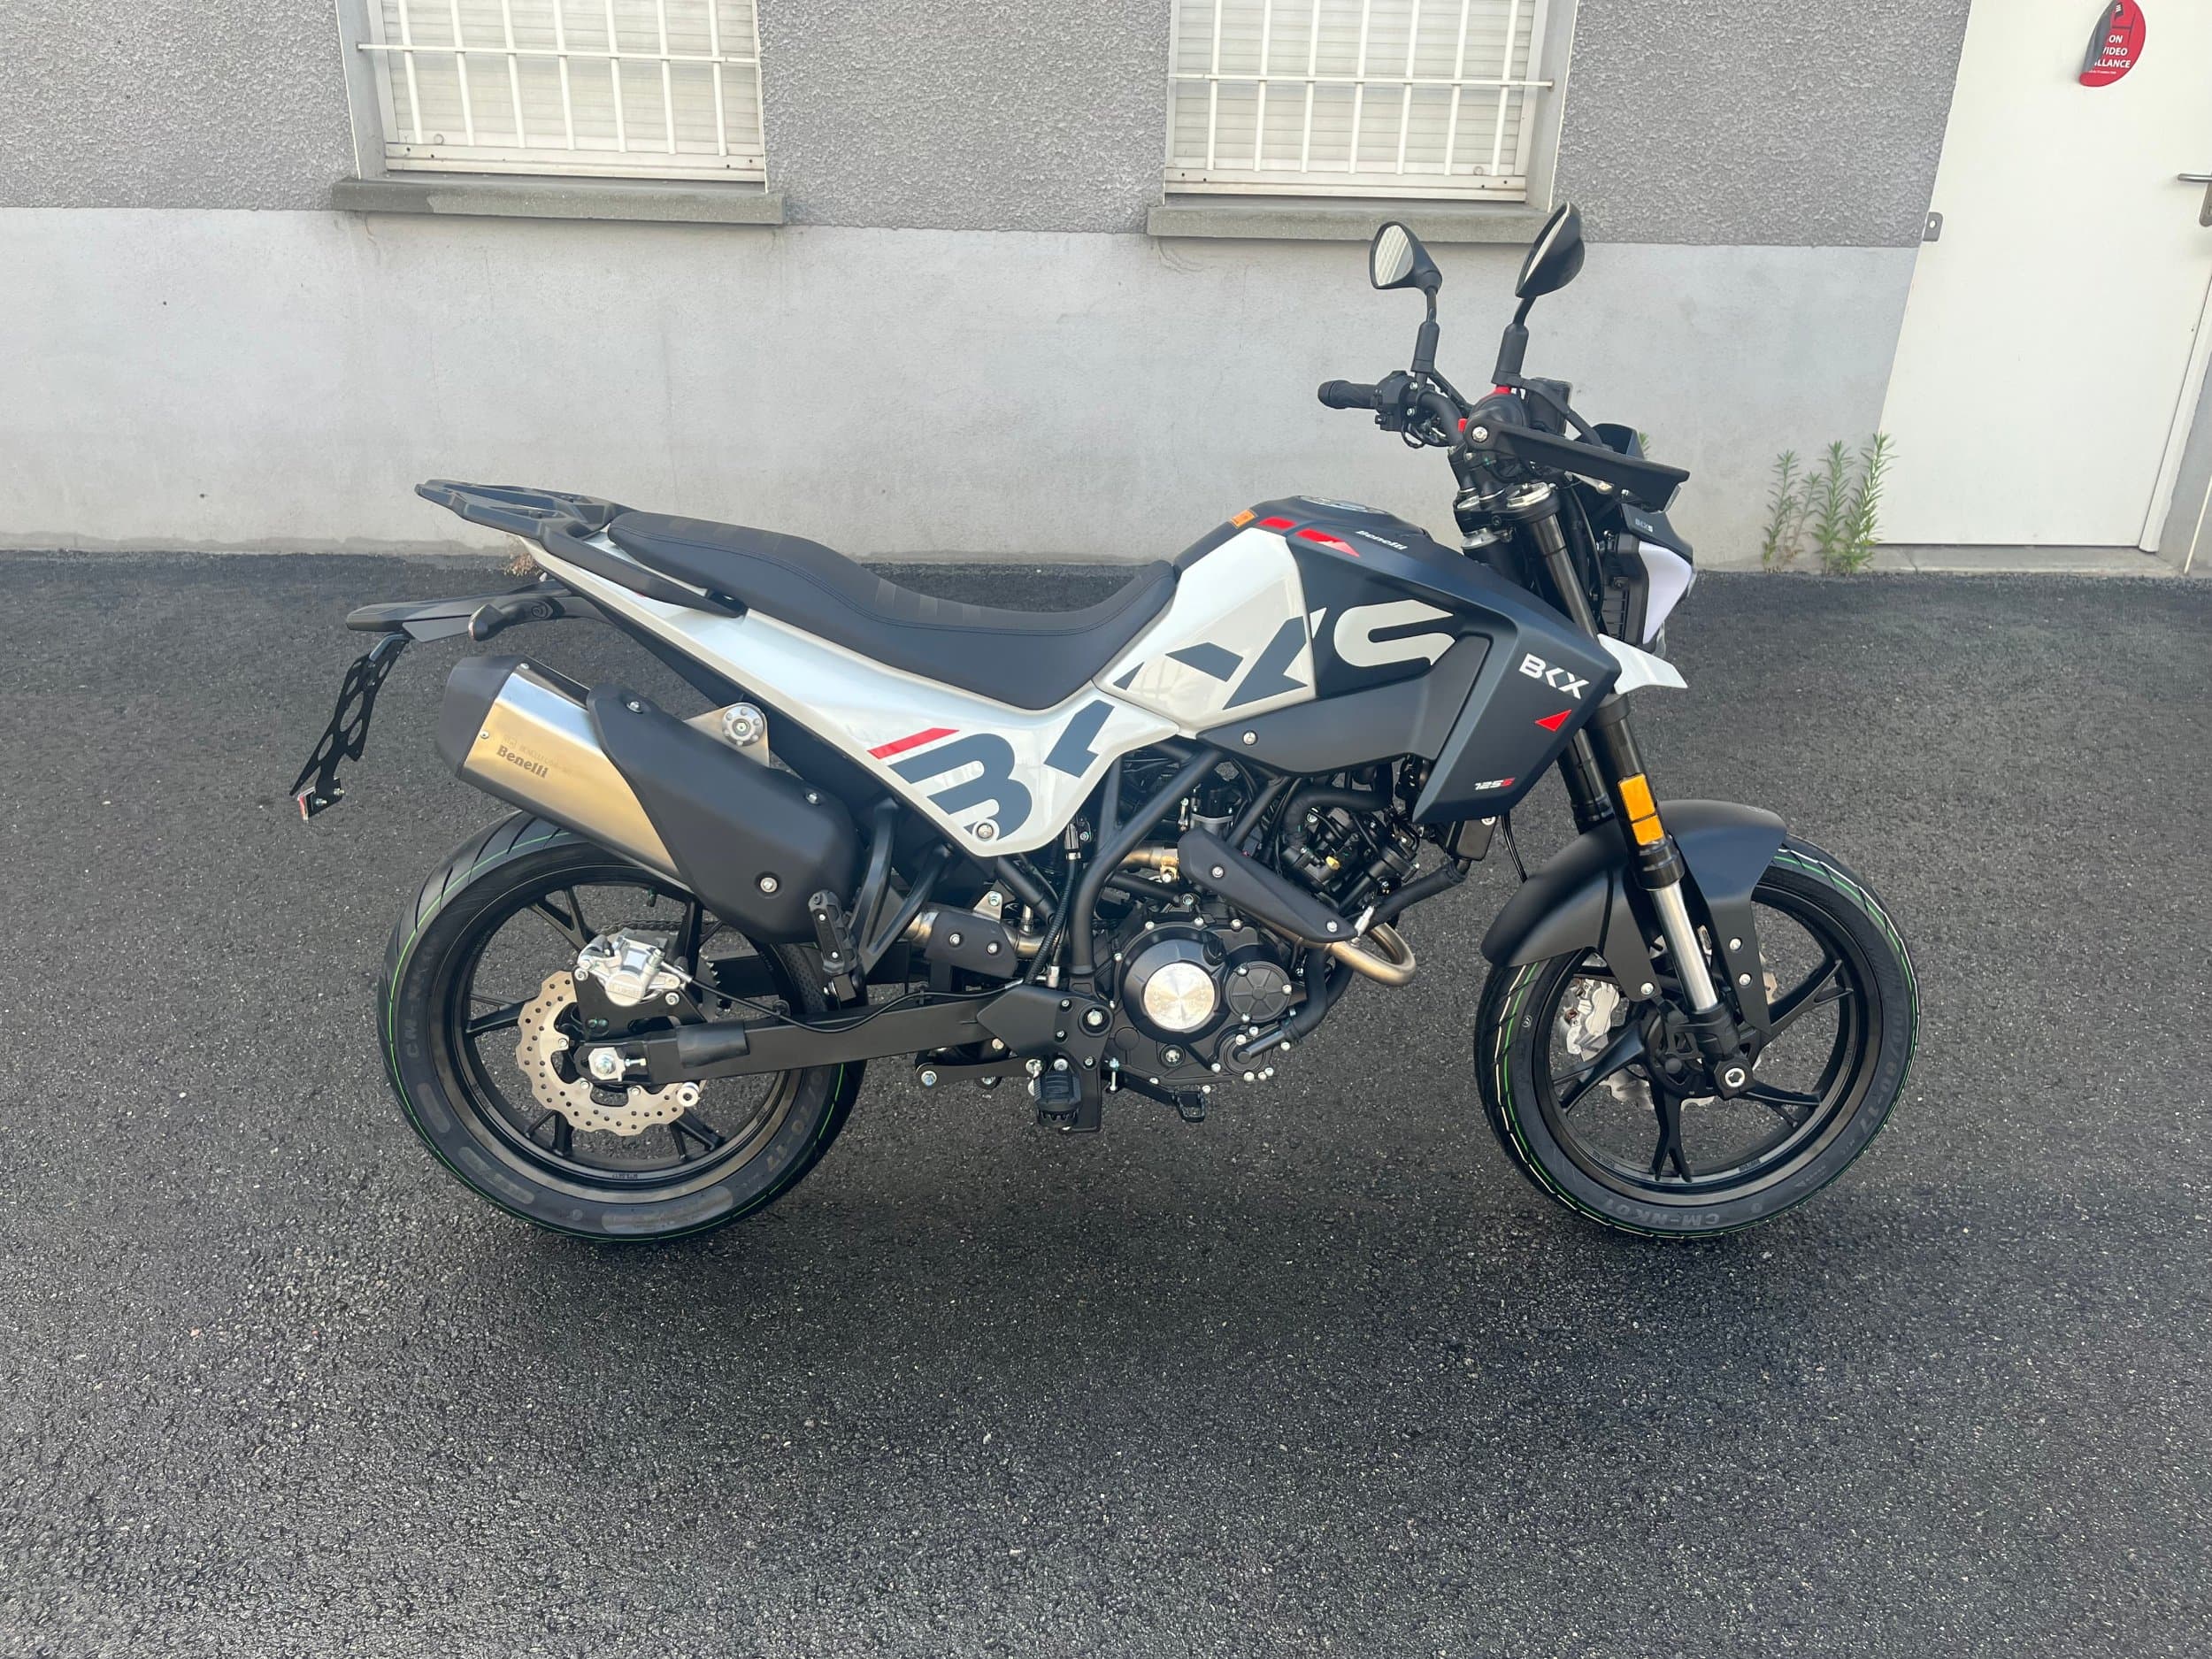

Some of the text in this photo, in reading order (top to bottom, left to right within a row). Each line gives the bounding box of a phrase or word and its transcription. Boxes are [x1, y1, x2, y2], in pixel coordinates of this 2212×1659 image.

[1356, 530, 1408, 550] Benelli
[1518, 653, 1589, 699] BKX
[496, 745, 549, 779] Benelli
